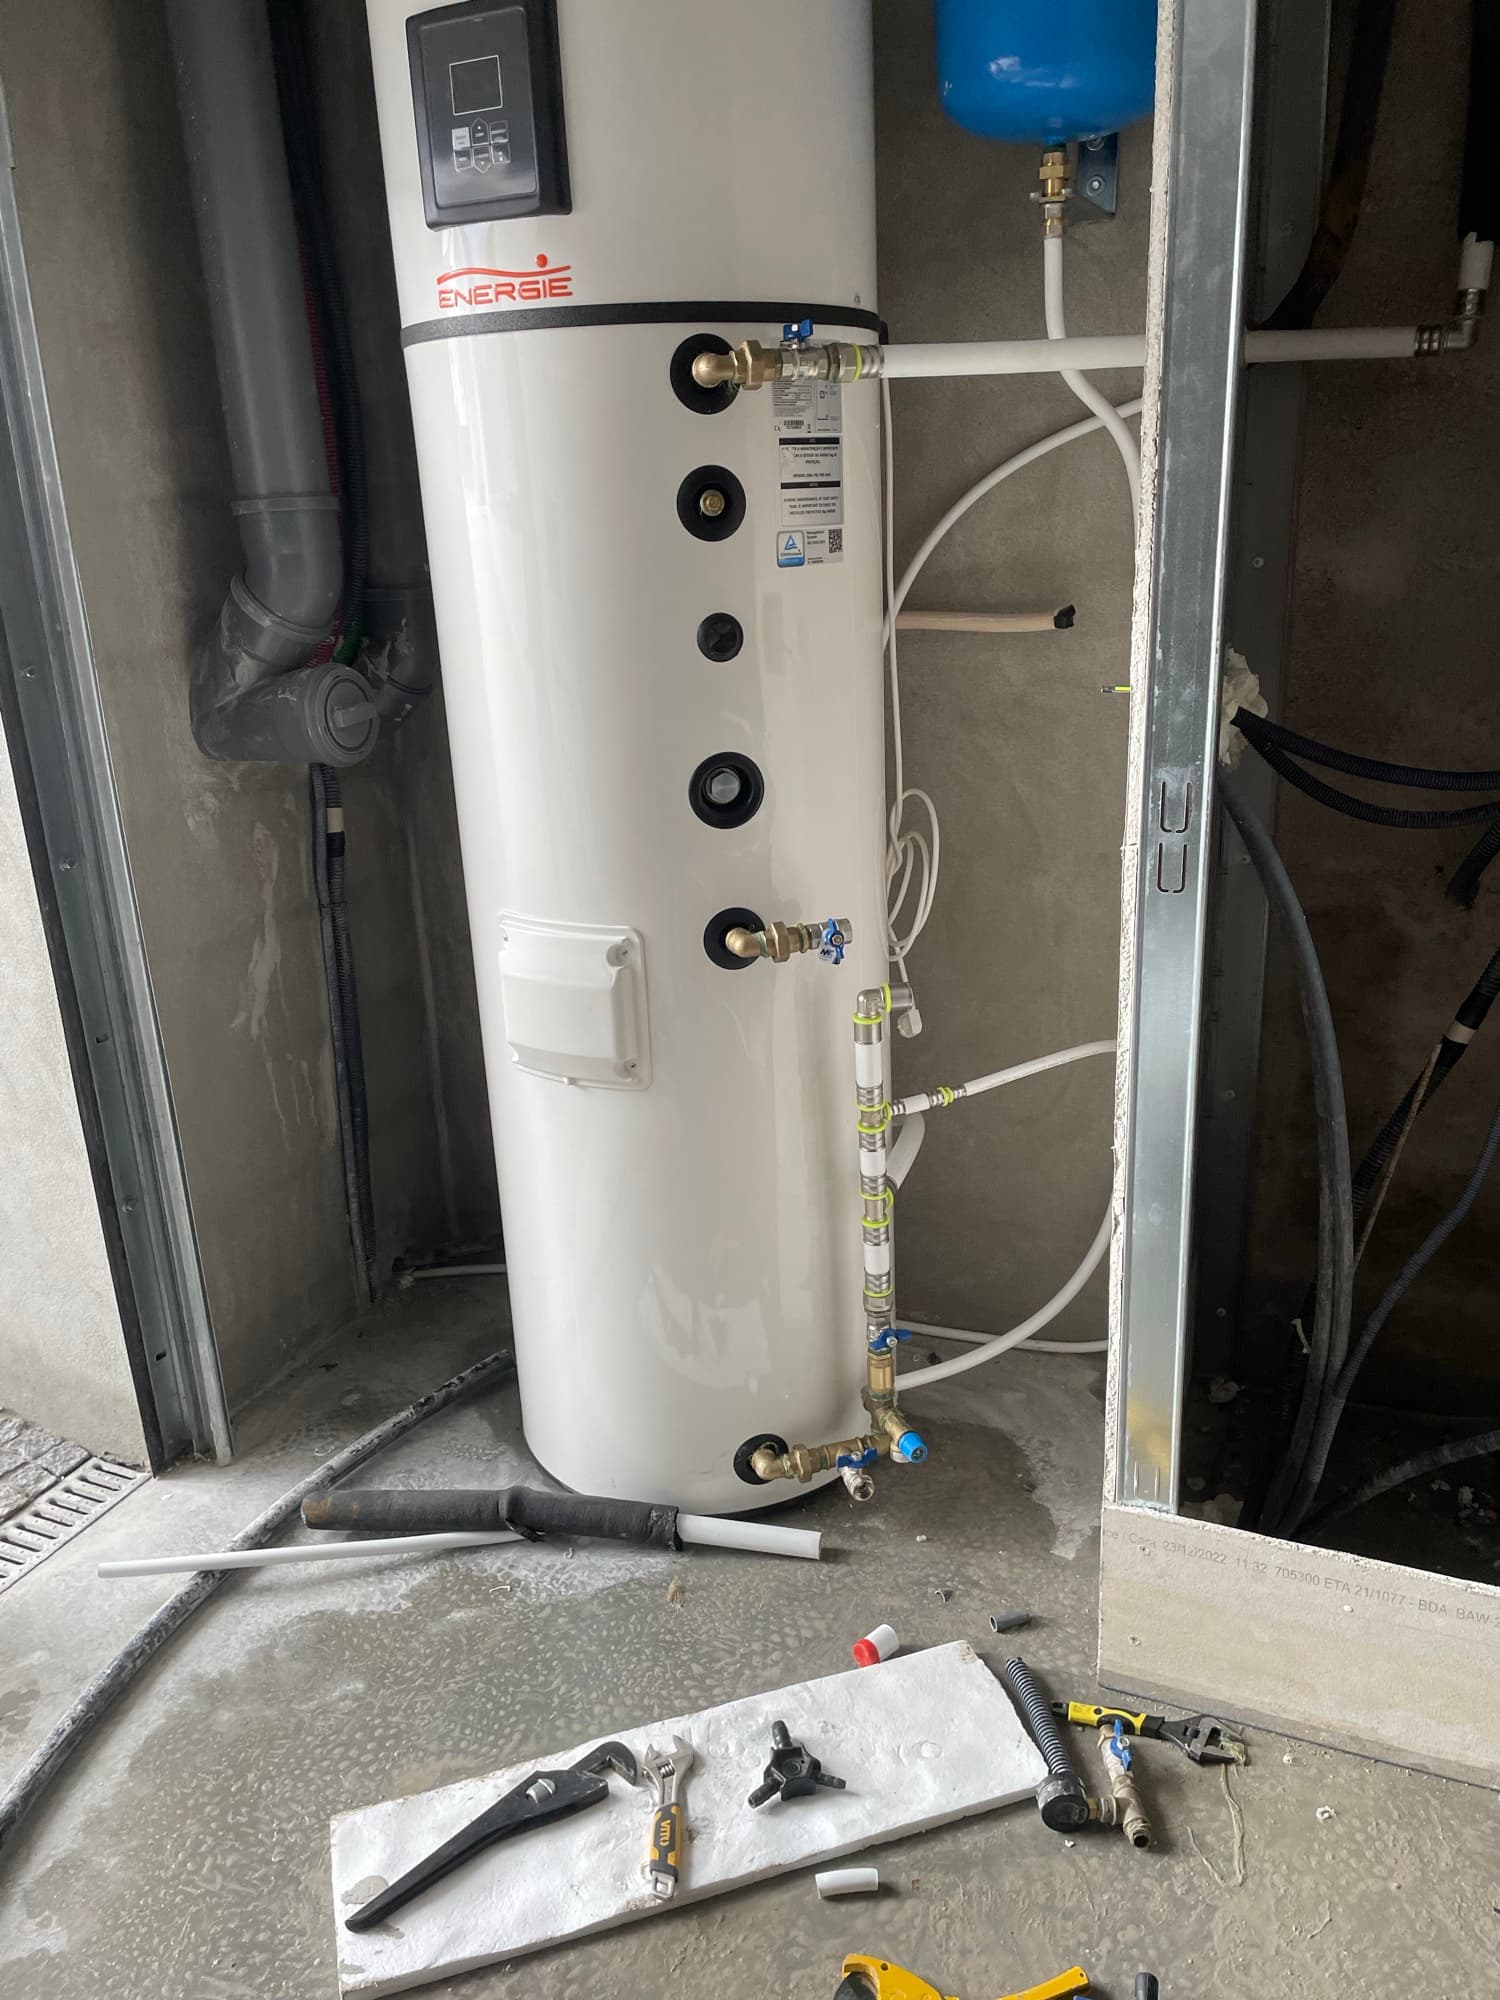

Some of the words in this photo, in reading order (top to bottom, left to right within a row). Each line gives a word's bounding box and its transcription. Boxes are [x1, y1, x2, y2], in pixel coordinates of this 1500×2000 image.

[437, 276, 573, 309] ENERGIE
[1275, 1566, 1320, 1586] 705300
[1324, 1577, 1351, 1593] ETA
[1354, 1584, 1406, 1605] 21/1077
[1418, 1599, 1448, 1616] BDA
